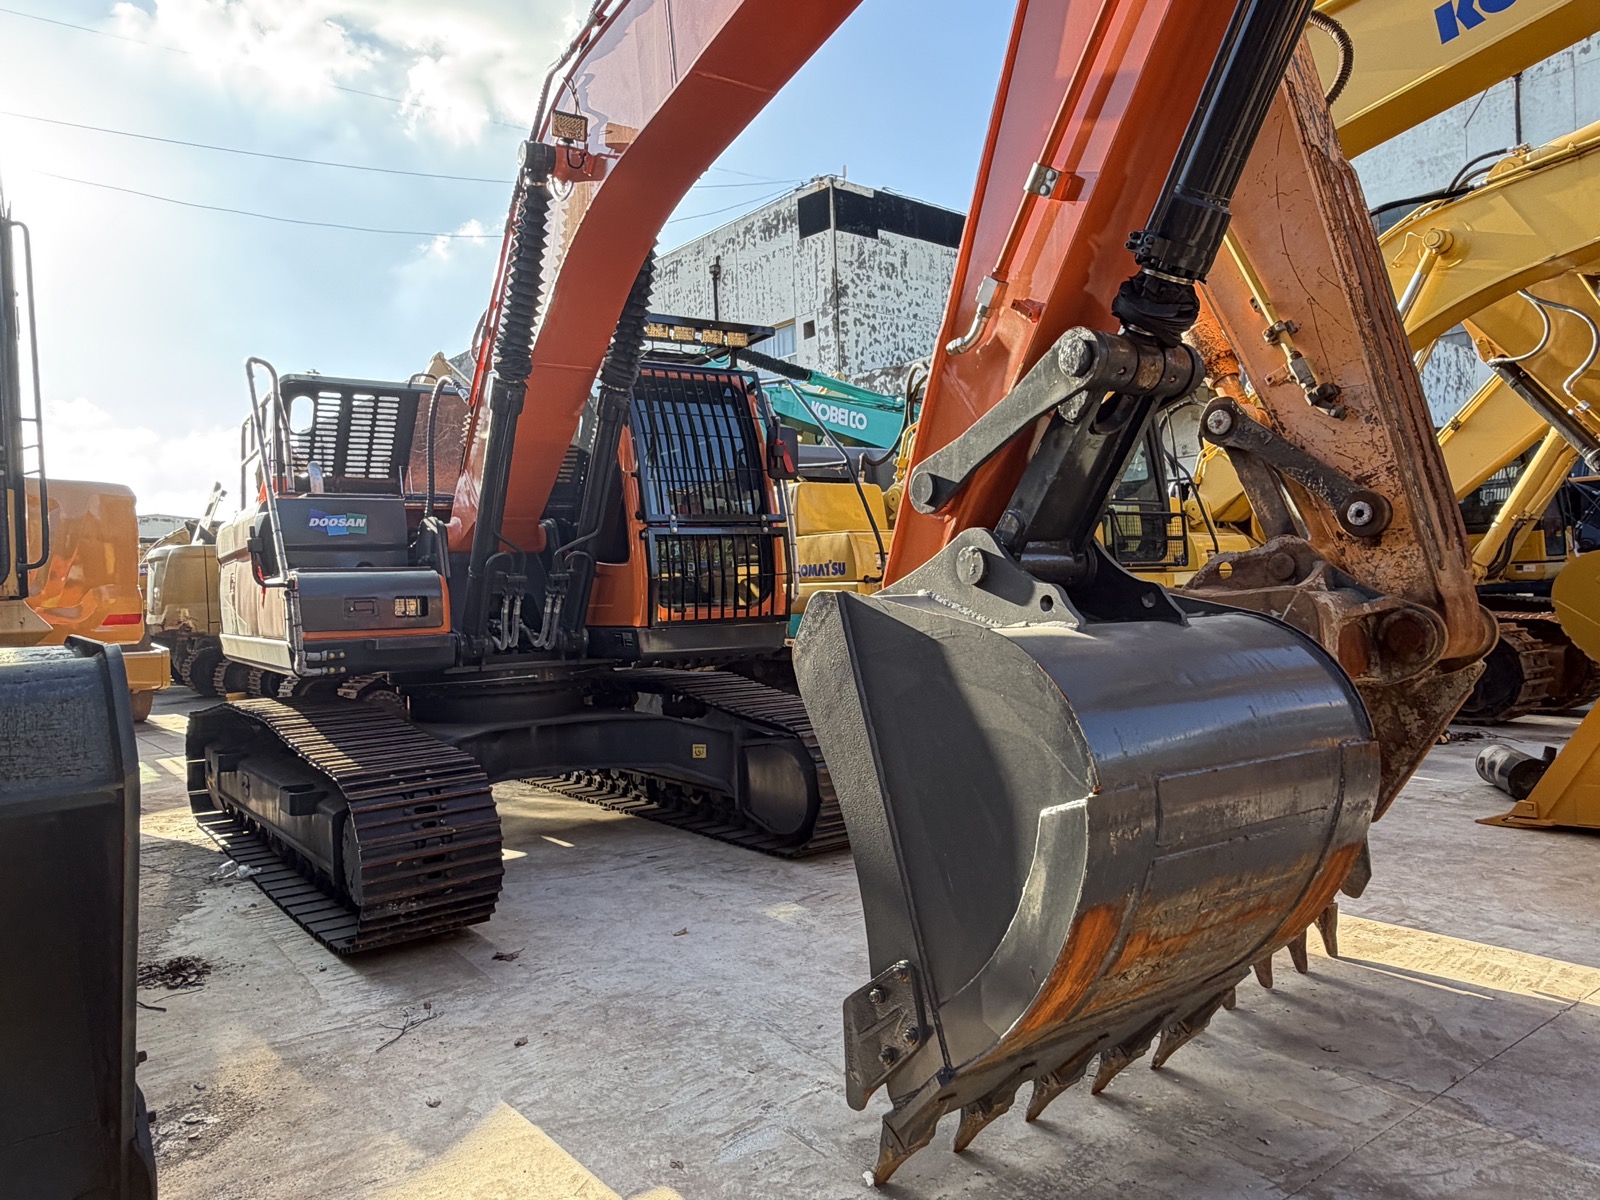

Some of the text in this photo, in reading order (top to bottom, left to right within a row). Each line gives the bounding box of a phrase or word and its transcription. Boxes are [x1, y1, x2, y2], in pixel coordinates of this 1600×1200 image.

[811, 400, 867, 430] KOBELCO
[309, 518, 366, 527] DOOSAN
[799, 560, 846, 577] OMATSU
